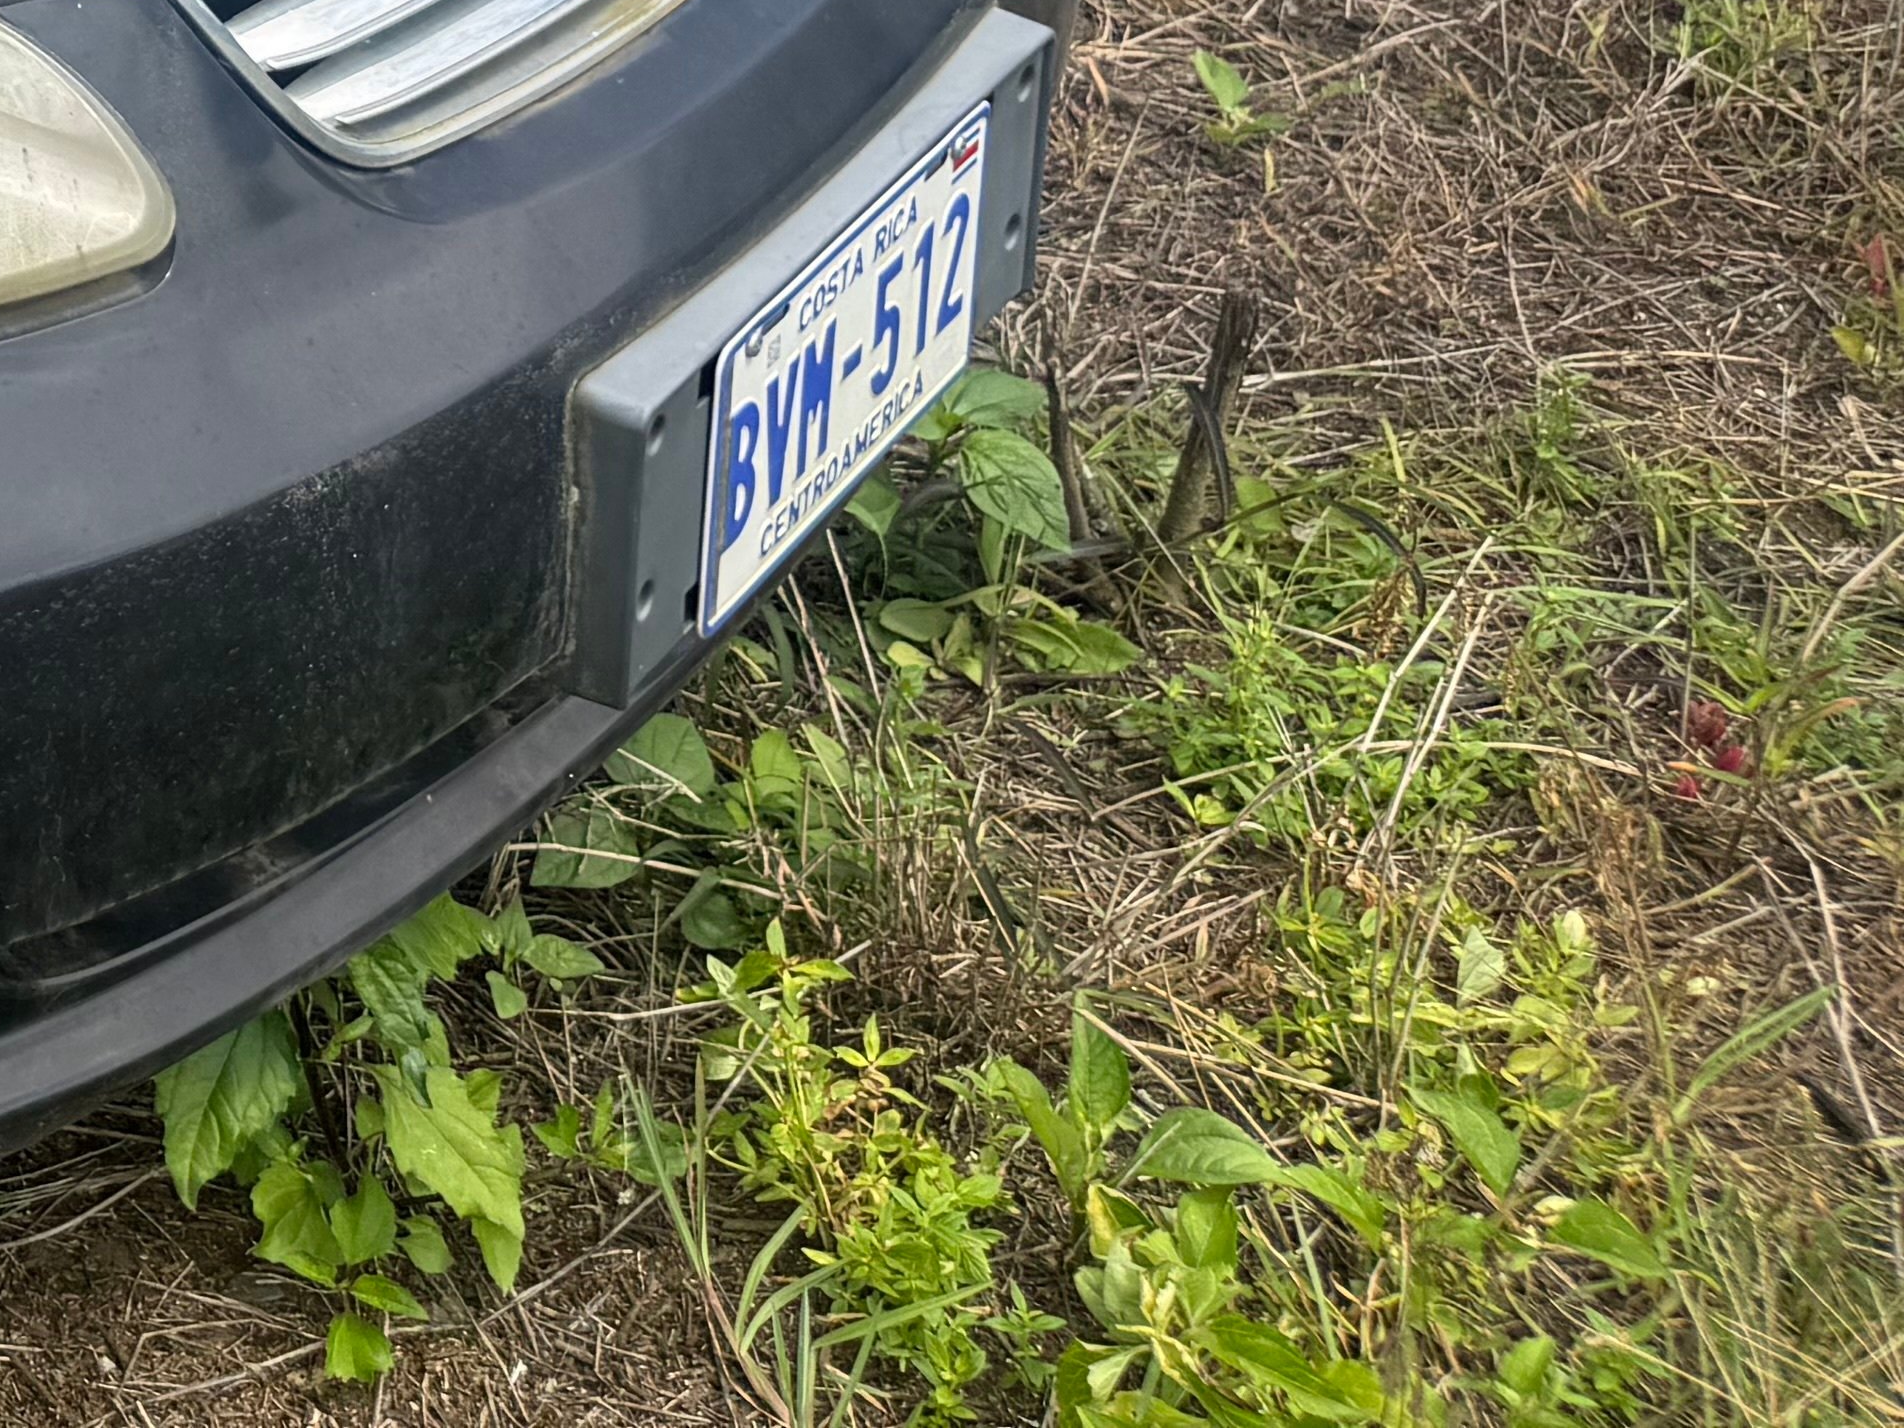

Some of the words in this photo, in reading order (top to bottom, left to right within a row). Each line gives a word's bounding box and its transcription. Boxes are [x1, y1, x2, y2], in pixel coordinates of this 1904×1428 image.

[798, 252, 864, 331] COSTA
[875, 194, 917, 256] RICA
[726, 192, 969, 549] BVM-512
[760, 369, 924, 556] CENTROAMERICA
